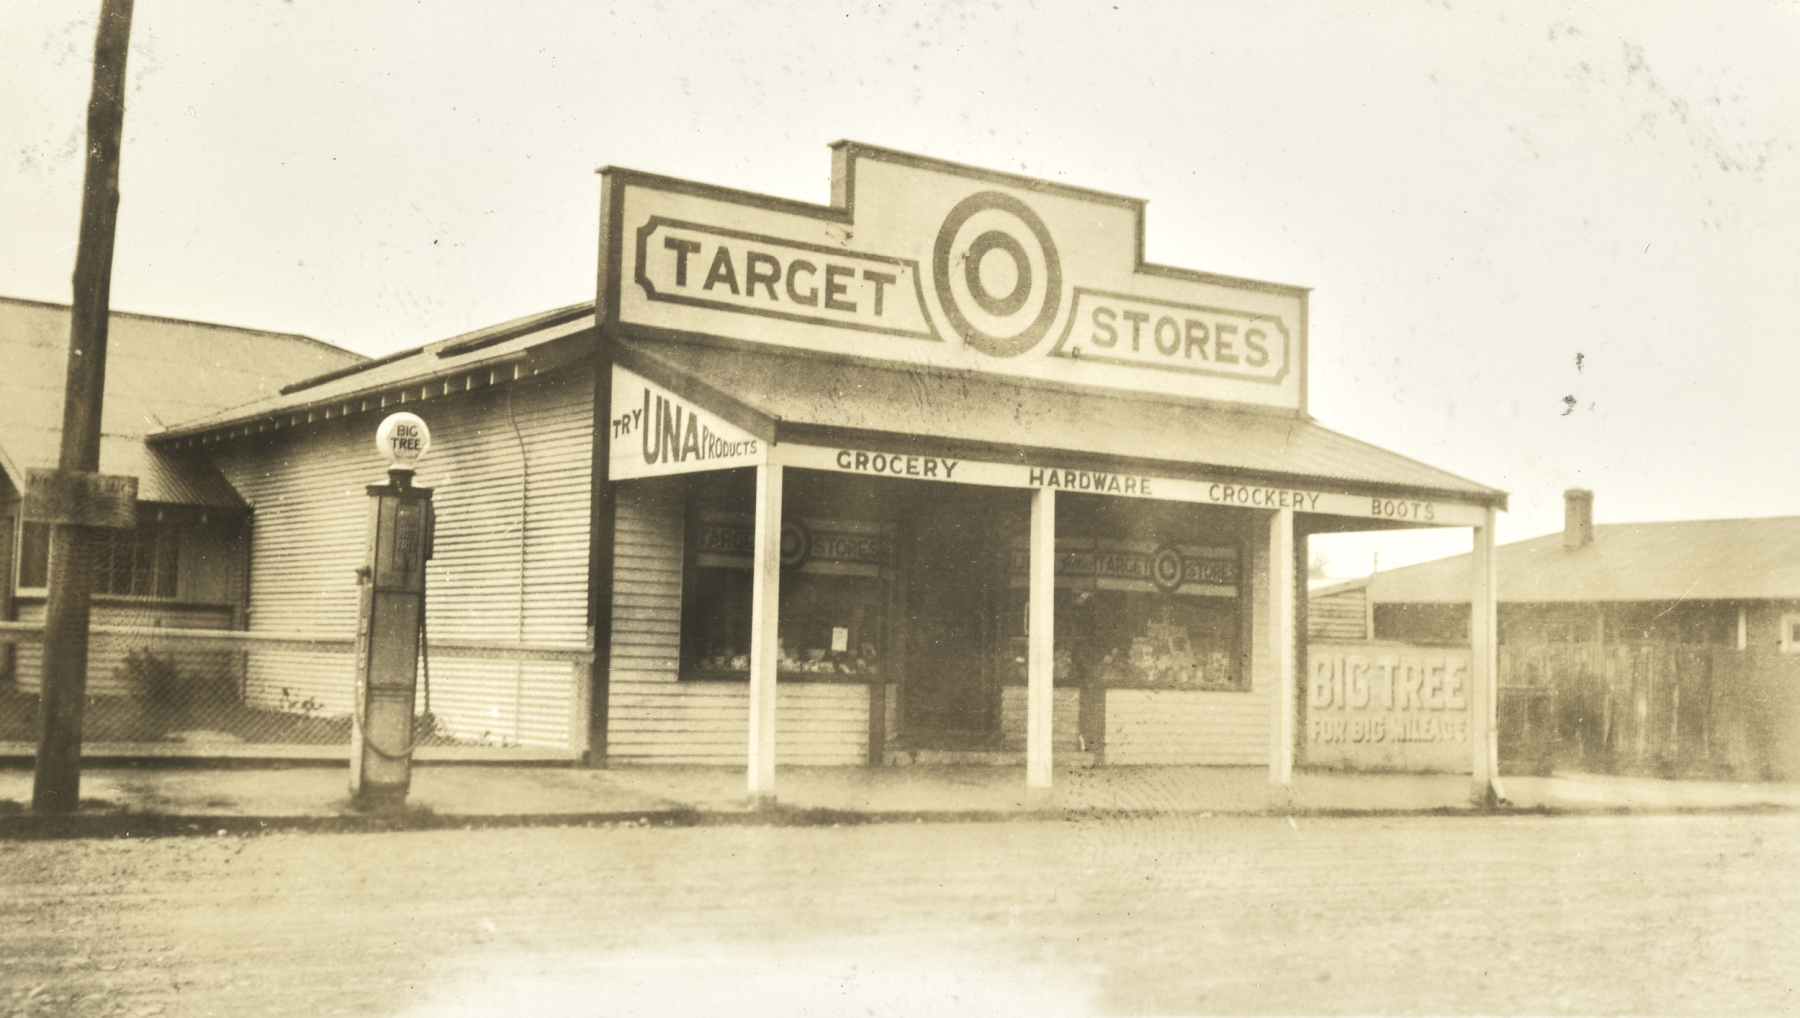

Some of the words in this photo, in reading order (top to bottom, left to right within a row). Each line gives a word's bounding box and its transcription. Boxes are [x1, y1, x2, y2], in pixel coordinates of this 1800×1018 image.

[664, 236, 897, 316] TARGET
[1091, 306, 1270, 369] STORES
[391, 438, 421, 450] TREE
[397, 425, 418, 437] BIG
[612, 409, 642, 438] TRY
[643, 387, 701, 465] UNA
[701, 425, 758, 460] PRODUCTS
[836, 450, 959, 478] GROCERY
[1029, 468, 1153, 495] HARDWARE
[1209, 484, 1320, 510] CROCKERY
[1371, 498, 1435, 520] BOOTS
[813, 536, 880, 558] STORES
[1310, 654, 1370, 710] BIG
[1378, 655, 1468, 711] TREE
[1311, 717, 1347, 743] FOR
[1352, 717, 1386, 743] BIG
[1390, 717, 1468, 744] MILEAGE
